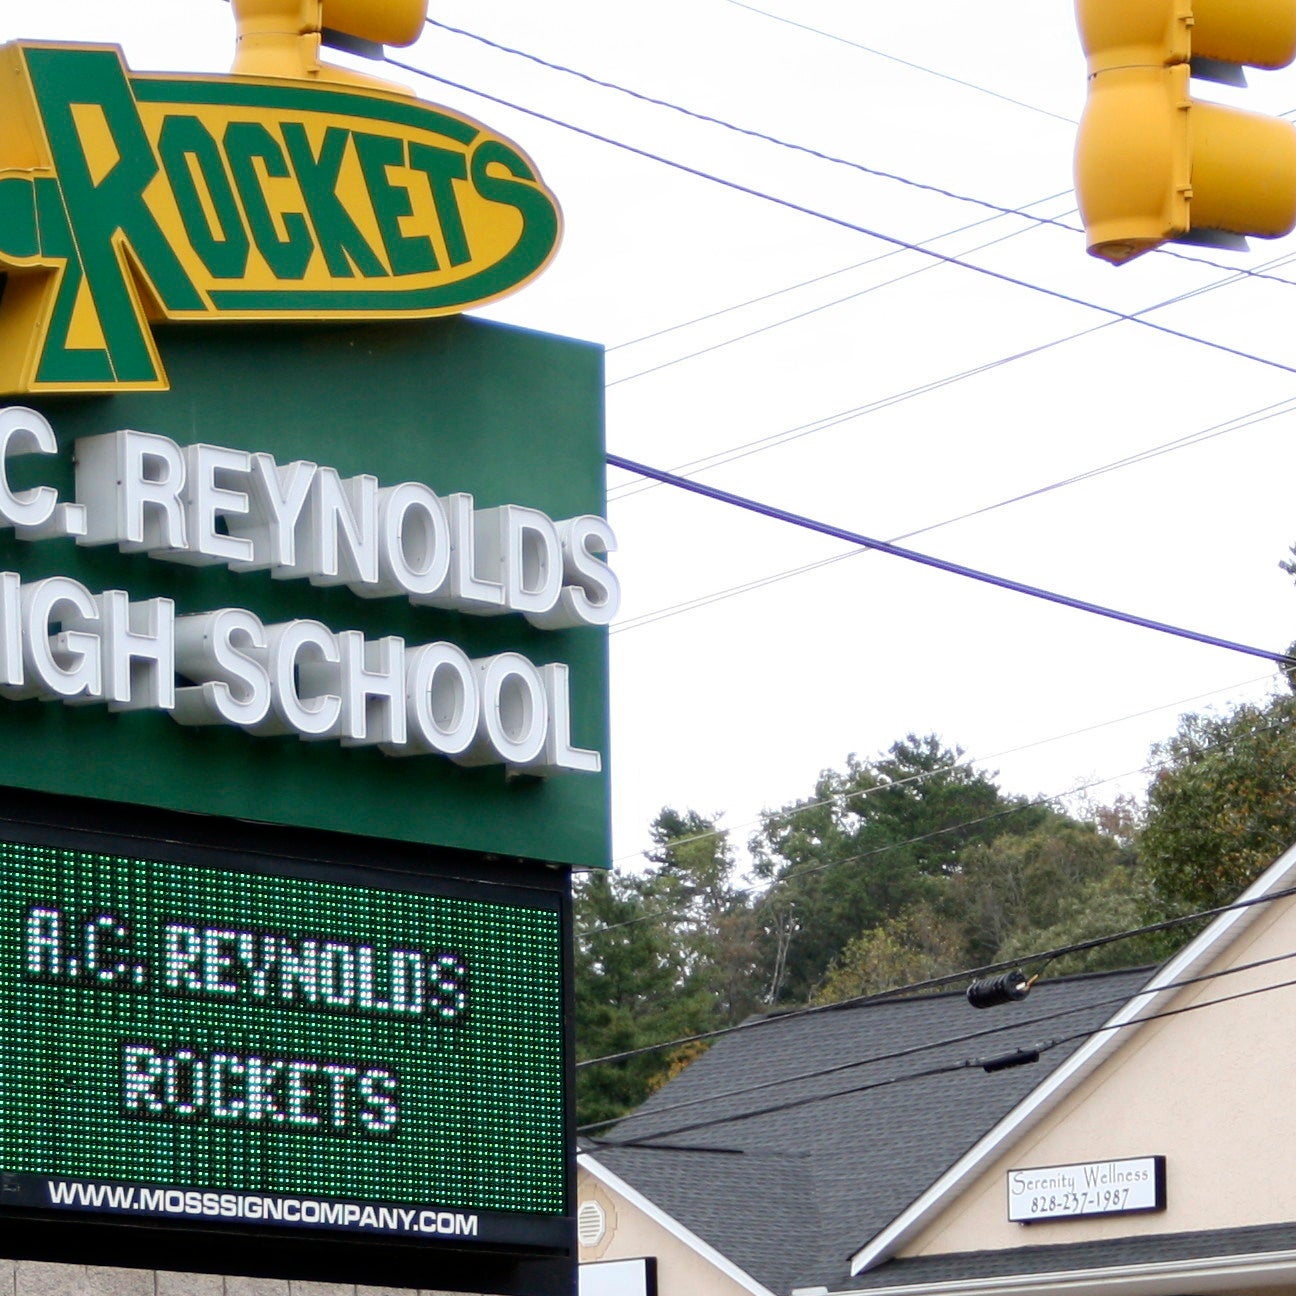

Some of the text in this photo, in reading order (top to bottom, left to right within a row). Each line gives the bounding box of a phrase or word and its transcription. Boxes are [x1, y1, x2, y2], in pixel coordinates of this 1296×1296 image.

[14, 46, 559, 384] ROCKETS
[79, 430, 620, 630] REYNOLDS
[178, 607, 601, 775] SCHOOL
[26, 906, 466, 1019] A.C. REYNOLDS
[123, 1042, 399, 1132] ROCKETS
[47, 1180, 478, 1237] WWW.MOSSSIGNCOMPANY.COM
[1011, 1164, 1149, 1196] Serenity Wellness
[1030, 1188, 1130, 1214] 828-237-1987
